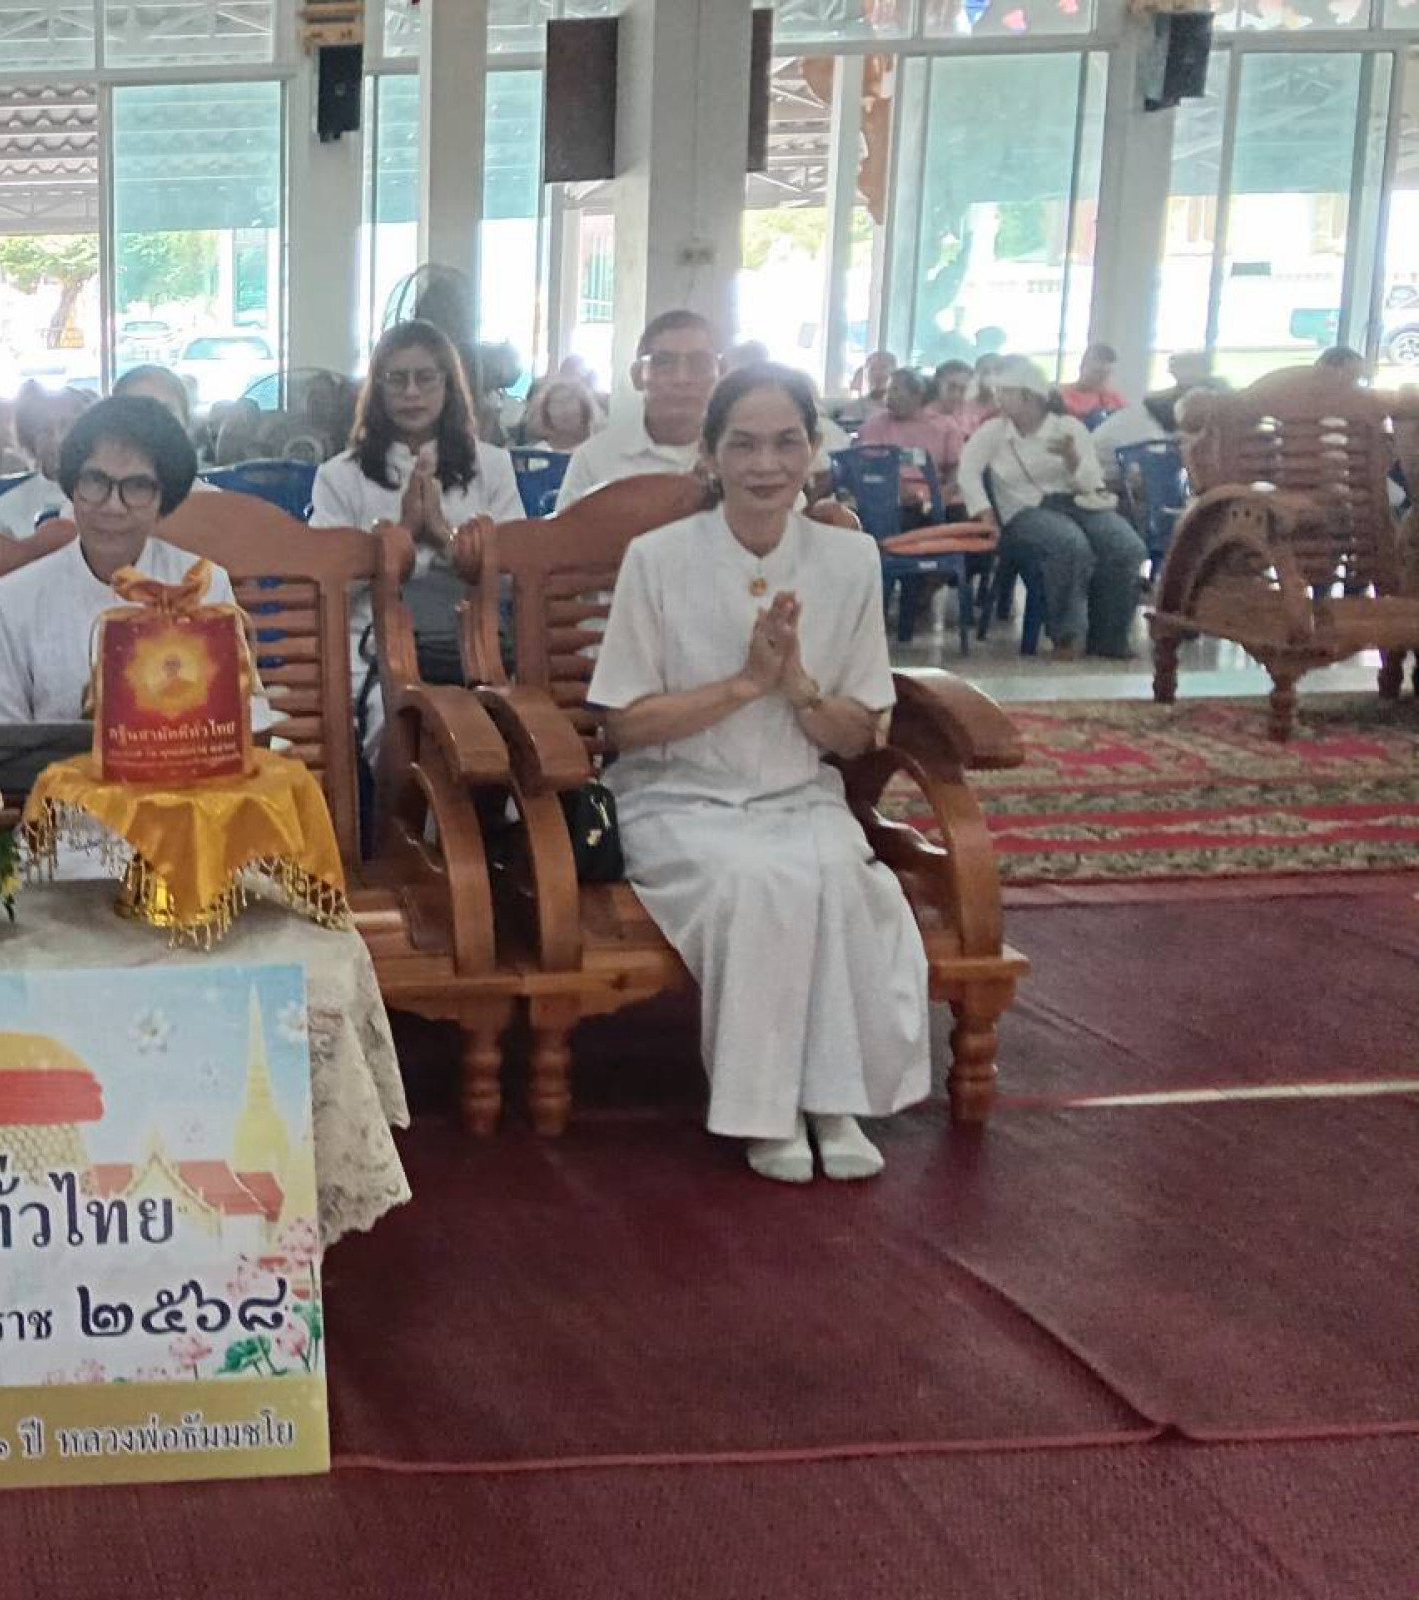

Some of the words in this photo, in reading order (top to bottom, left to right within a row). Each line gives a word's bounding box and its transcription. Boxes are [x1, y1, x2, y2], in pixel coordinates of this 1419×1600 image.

[77, 1277, 288, 1337] ๒๕๖๘
[19, 1416, 44, 1457] ปี
[56, 1409, 294, 1457] หลวงพ่อธัมมชโย
